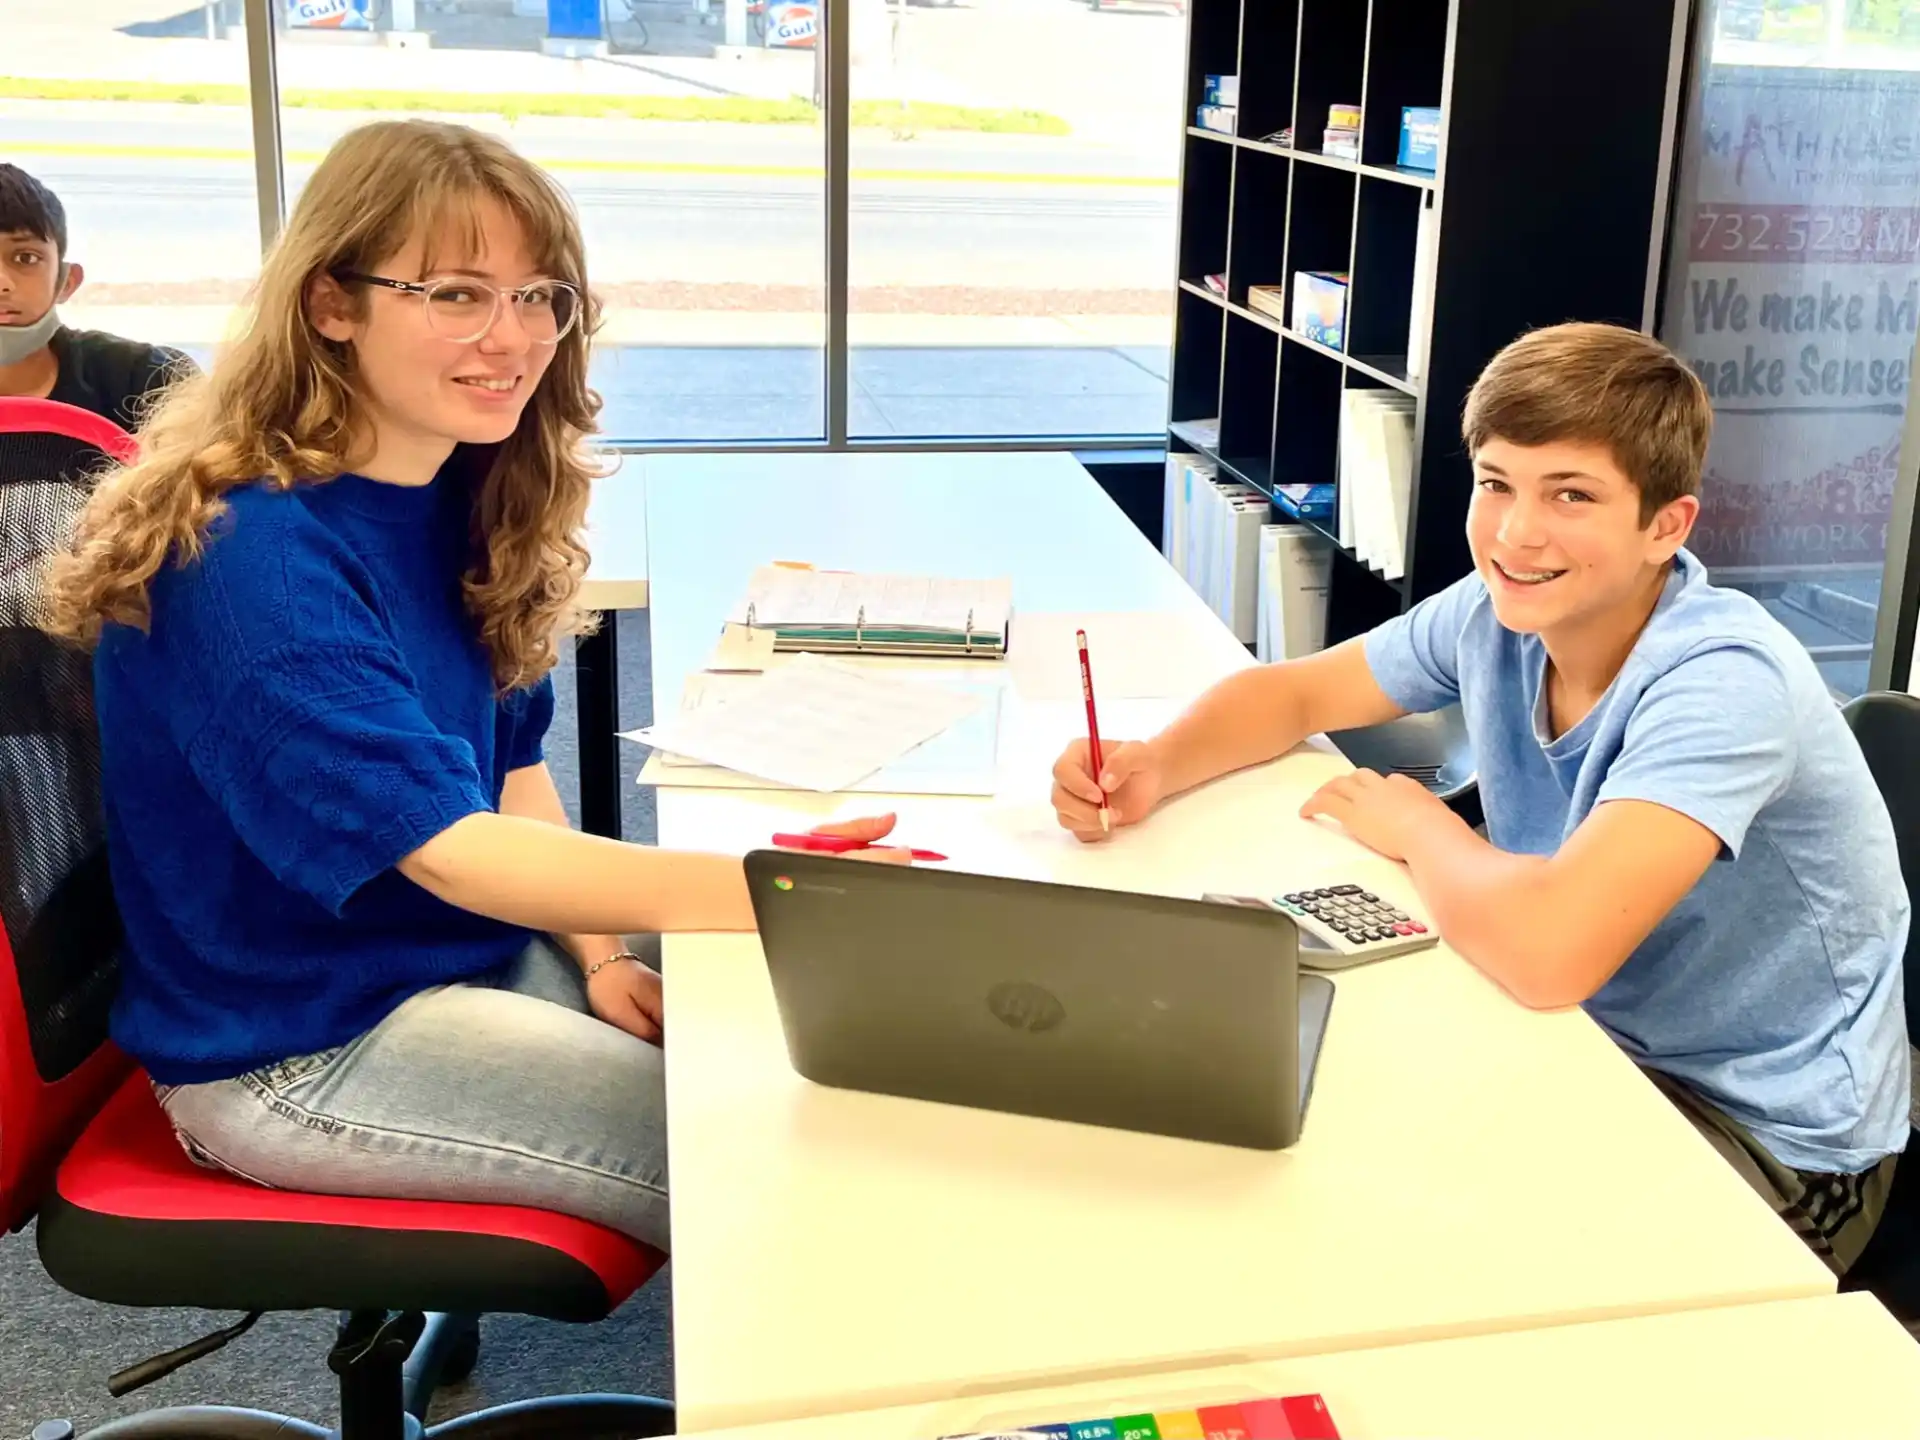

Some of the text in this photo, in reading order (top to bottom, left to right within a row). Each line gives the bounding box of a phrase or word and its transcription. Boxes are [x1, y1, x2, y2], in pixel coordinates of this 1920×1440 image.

[778, 21, 812, 38] Gul
[1692, 278, 1750, 334] We
[1760, 280, 1864, 334] make
[1694, 522, 1873, 556] OMEWORK
